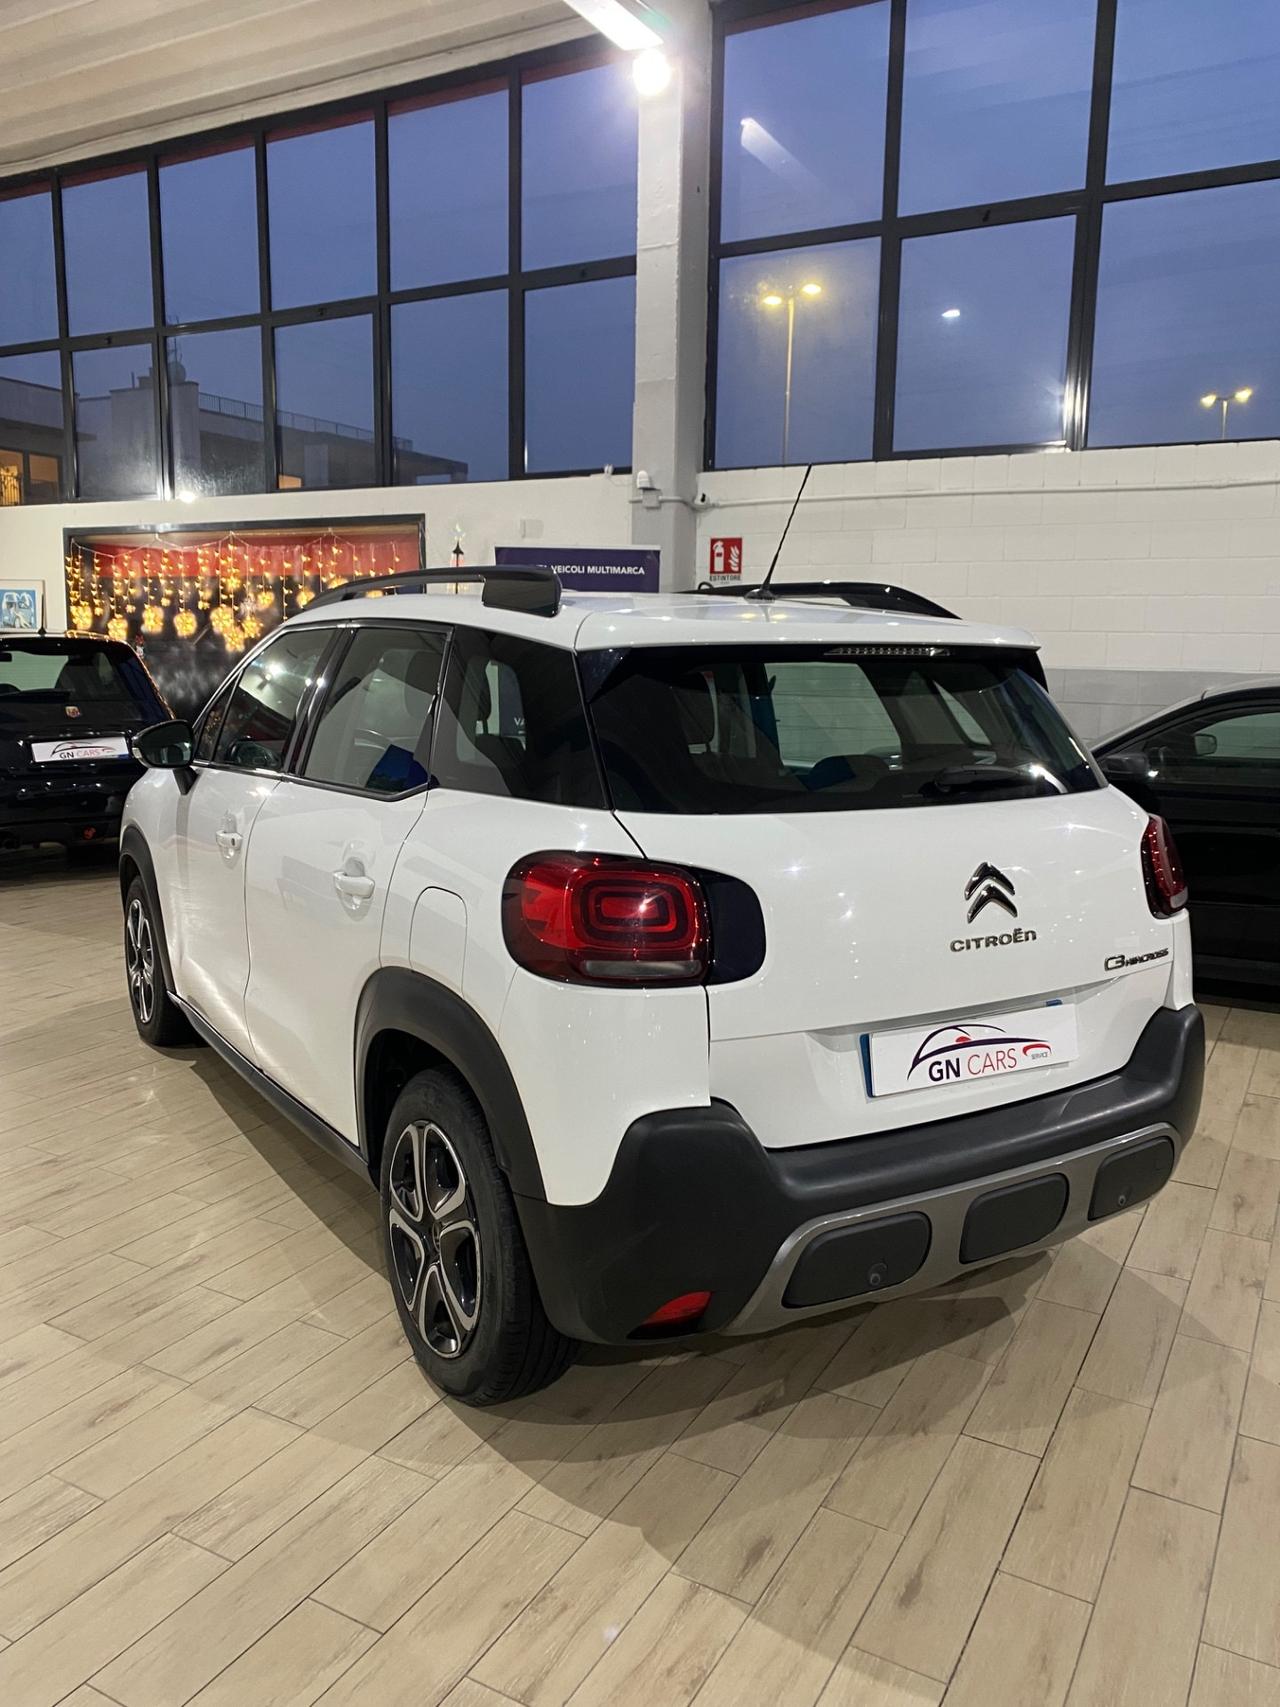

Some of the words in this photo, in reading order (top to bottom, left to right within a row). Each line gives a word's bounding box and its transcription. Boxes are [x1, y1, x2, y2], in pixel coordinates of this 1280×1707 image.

[551, 564, 585, 575] VEICOLI
[587, 565, 645, 576] MULTIMARCA
[59, 751, 75, 760] GN
[76, 748, 100, 758] CARS
[928, 1057, 961, 1082] GN
[967, 1047, 1018, 1076] CARS
